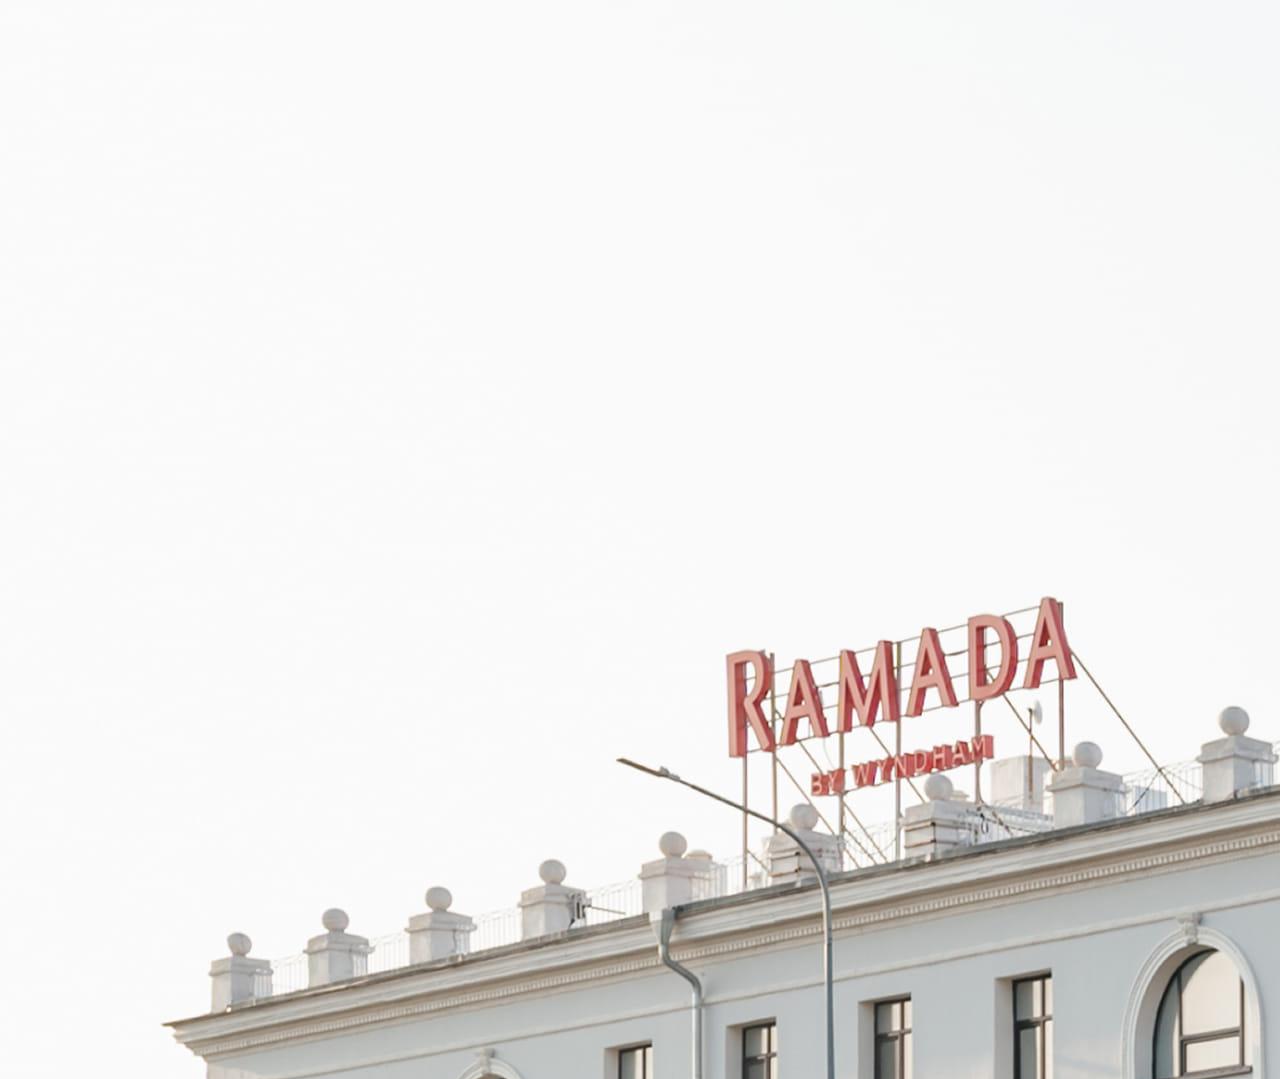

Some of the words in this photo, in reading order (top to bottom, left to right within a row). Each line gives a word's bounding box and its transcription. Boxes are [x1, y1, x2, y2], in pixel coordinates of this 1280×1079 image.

[726, 596, 1078, 757] RAMADA
[811, 768, 845, 796] BY
[852, 735, 994, 787] WYNDHAM
